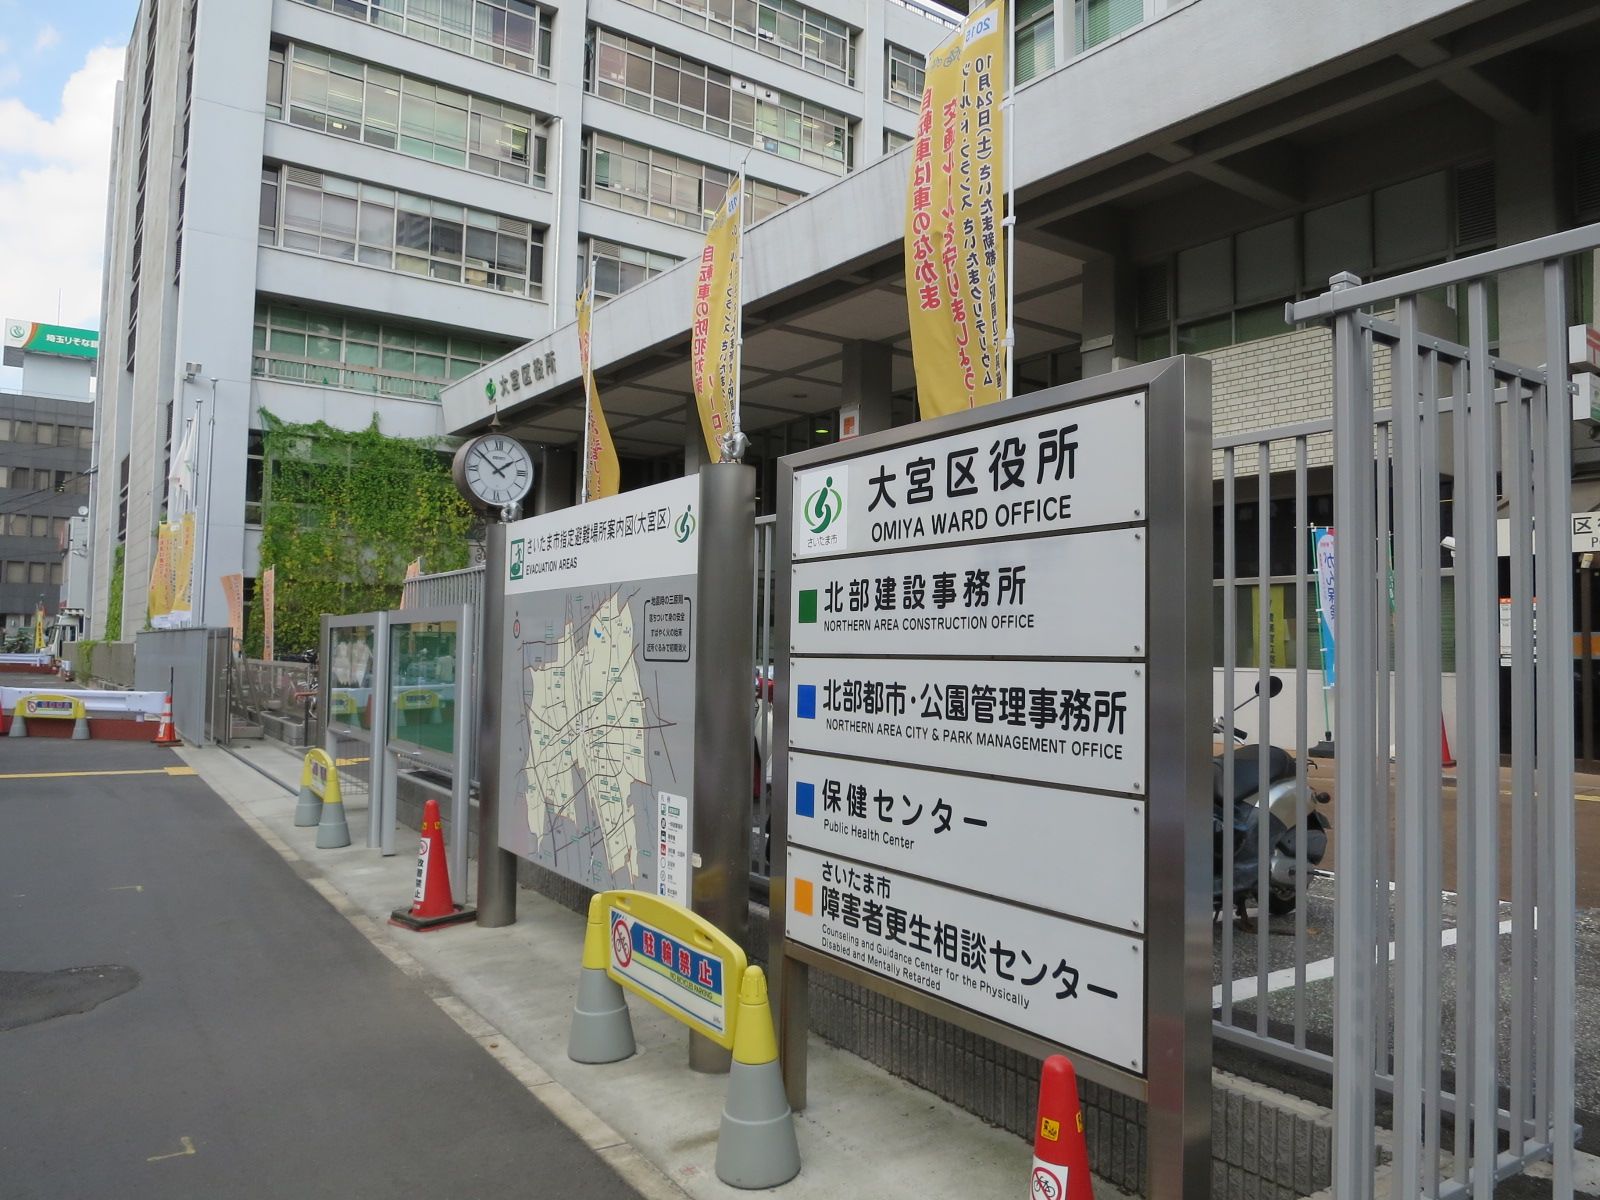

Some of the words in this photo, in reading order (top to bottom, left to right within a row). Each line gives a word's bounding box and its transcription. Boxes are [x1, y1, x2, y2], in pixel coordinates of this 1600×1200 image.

[499, 350, 556, 397] 大宮区役所
[868, 423, 1078, 512] 大宮区役所
[527, 506, 671, 554] さいたま市指定避難場所案内図(大宮区)
[807, 534, 838, 548] さいたま市
[871, 516, 925, 542] OMIYA
[932, 507, 988, 535] WARD
[995, 495, 1072, 527] OFFICE
[526, 560, 557, 575] EVACUATION
[559, 557, 577, 570] AREAS
[824, 565, 1026, 614] 北部建設事務所
[824, 618, 871, 632] NORTHERN
[874, 617, 899, 631] AREA
[902, 616, 988, 631] CONSTRUCTION
[991, 614, 1035, 628] OFFICE
[822, 679, 1127, 735] 北部都市・公園管理事務所
[826, 718, 874, 734] NORTHERN
[877, 722, 902, 737] AREA
[905, 726, 928, 740] CITY
[932, 729, 940, 741] &
[943, 730, 973, 745] PARK
[976, 733, 1067, 754] MANAGEMENT
[1071, 741, 1123, 760] OFFICE
[822, 778, 988, 834] 保健センター
[824, 818, 849, 835] Public
[851, 824, 879, 841] Health
[883, 831, 915, 850] Center
[822, 861, 891, 899] さいたま市
[643, 931, 713, 988] 駐輪禁止
[822, 885, 1118, 1000] 障害者更生相談センター
[822, 936, 851, 957] Disabled
[853, 948, 866, 962] and
[868, 952, 900, 976] Mentally
[903, 967, 940, 991] Retarded
[822, 924, 859, 946] Counseling
[861, 937, 875, 951] and
[877, 942, 912, 965] Guidance
[915, 957, 943, 975] Center
[946, 968, 960, 981] for
[962, 973, 977, 987] the
[980, 980, 1030, 1009] Physically
